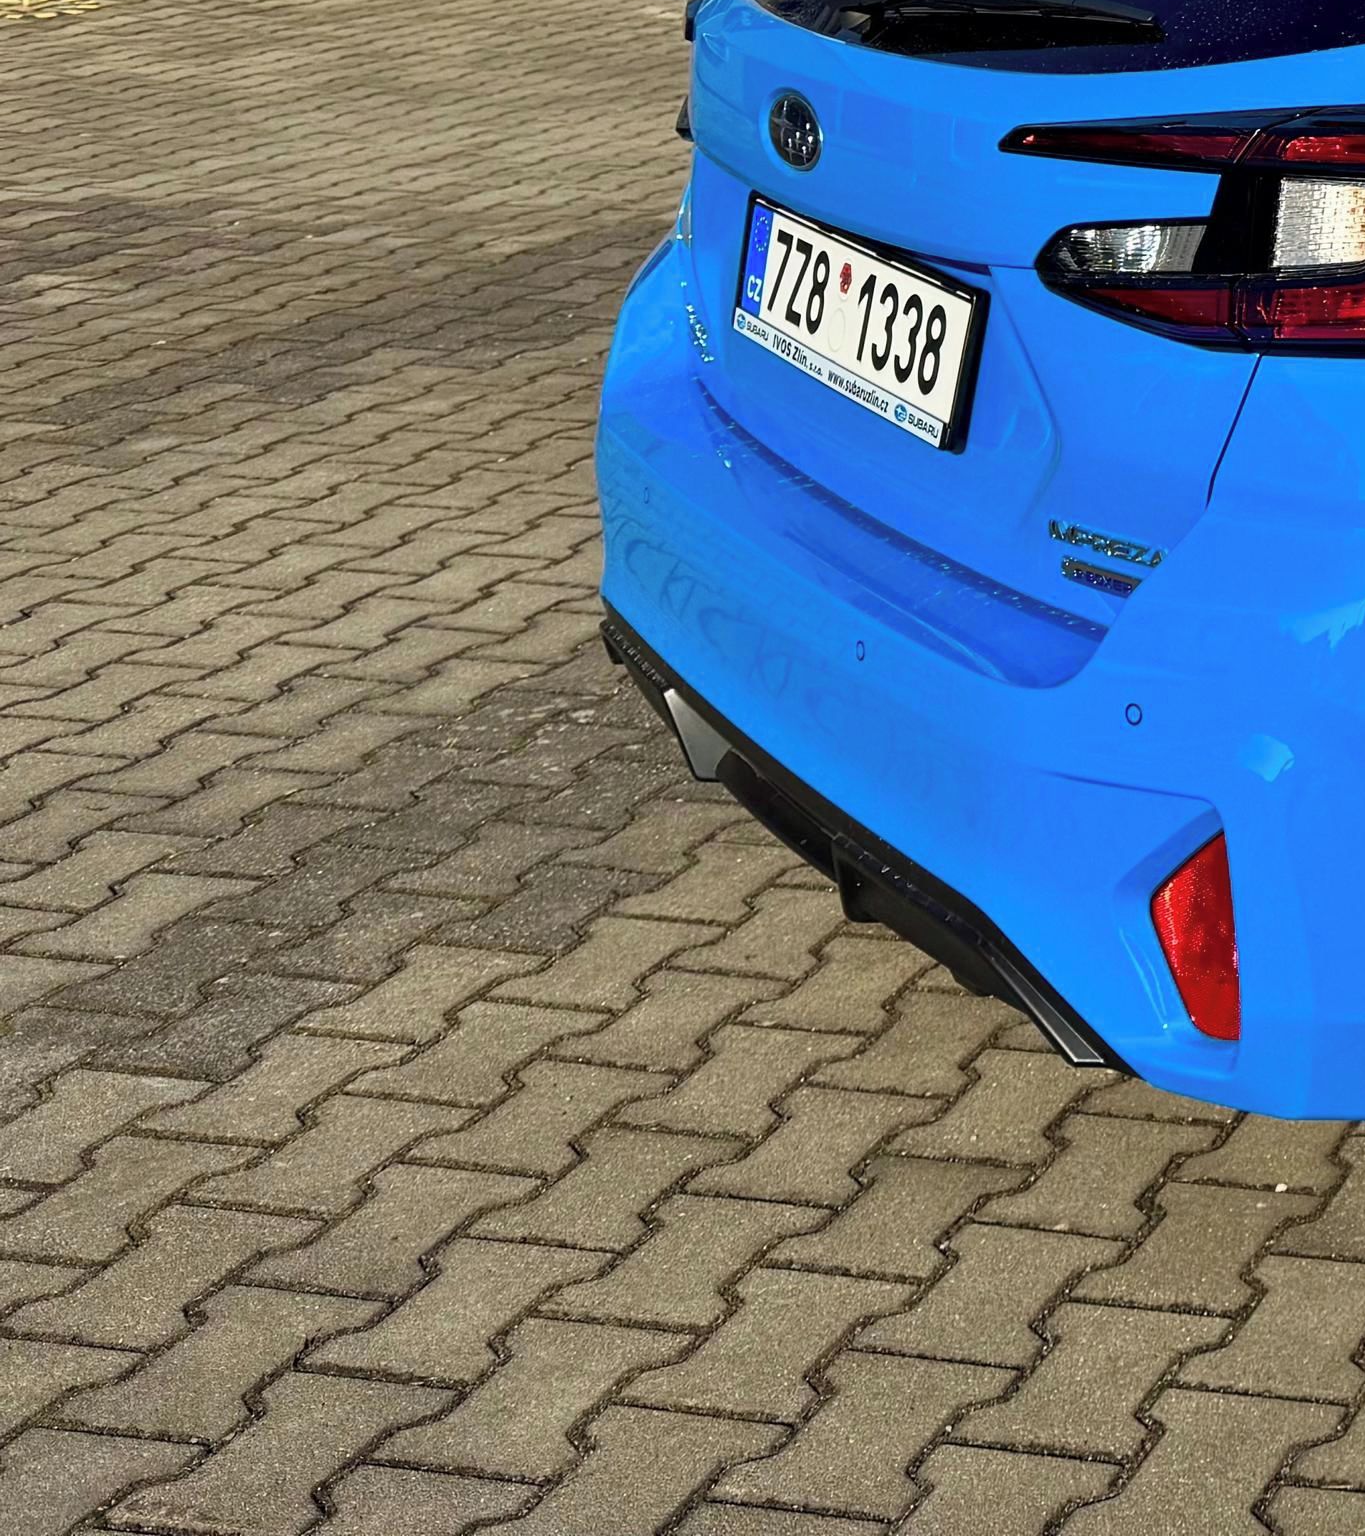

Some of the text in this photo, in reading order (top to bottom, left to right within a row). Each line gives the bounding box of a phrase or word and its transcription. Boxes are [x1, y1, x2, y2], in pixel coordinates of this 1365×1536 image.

[746, 275, 762, 304] CZ
[767, 228, 947, 396] 7Z8 1338
[746, 321, 769, 342] SUBARU
[772, 333, 792, 358] IVOS
[809, 361, 823, 377] s.r.o.
[827, 369, 889, 413] www.subaruzlin.cz
[907, 413, 940, 439] SUBARU
